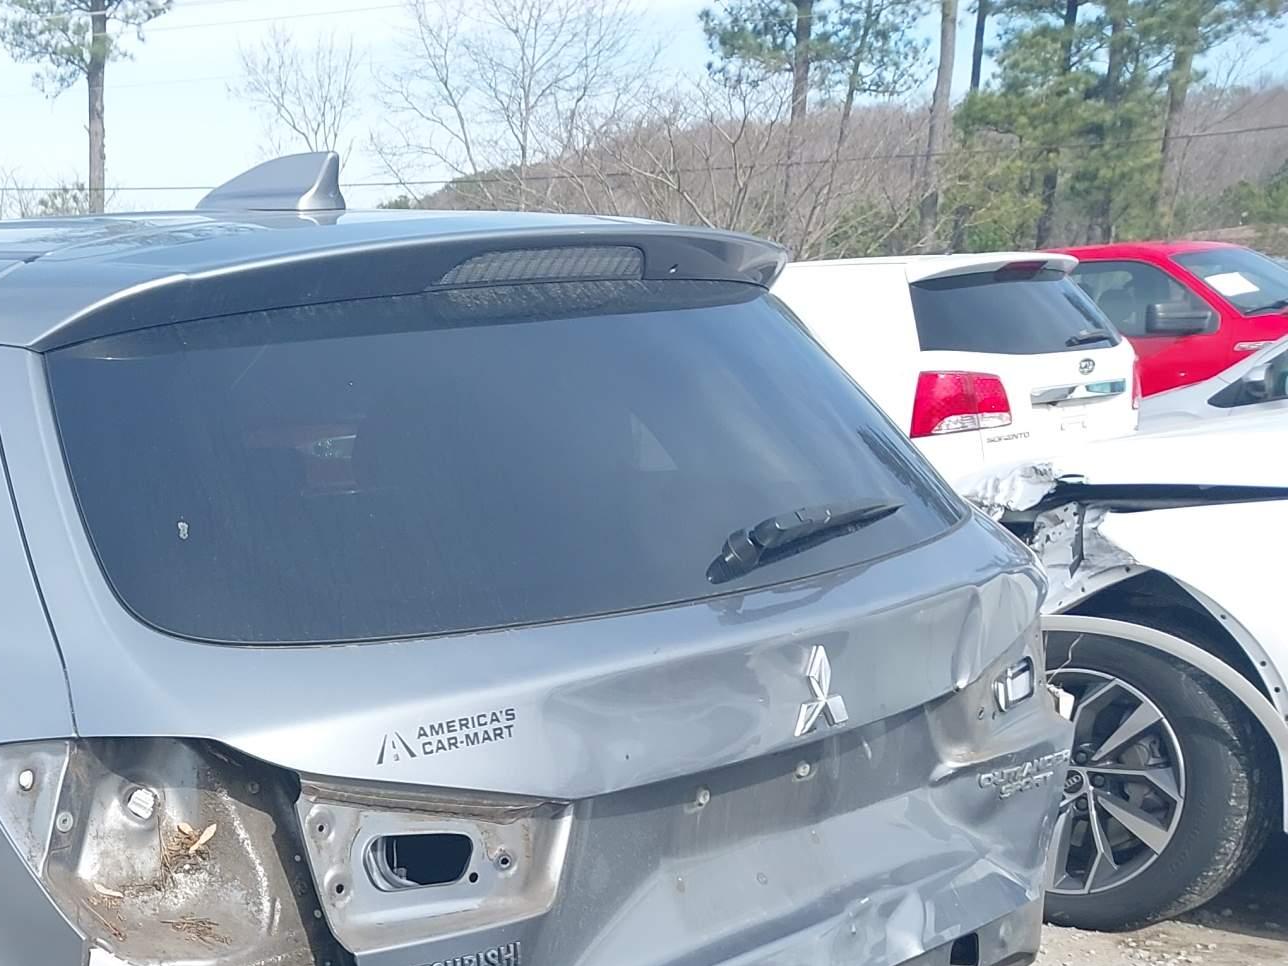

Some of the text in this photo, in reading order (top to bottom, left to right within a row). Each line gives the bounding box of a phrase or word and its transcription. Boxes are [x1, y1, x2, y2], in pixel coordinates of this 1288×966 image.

[417, 708, 516, 739] AMERICA'S
[421, 725, 515, 755] CAR-MART
[977, 749, 1070, 788] OUTLANDER
[999, 771, 1053, 800] SPORT
